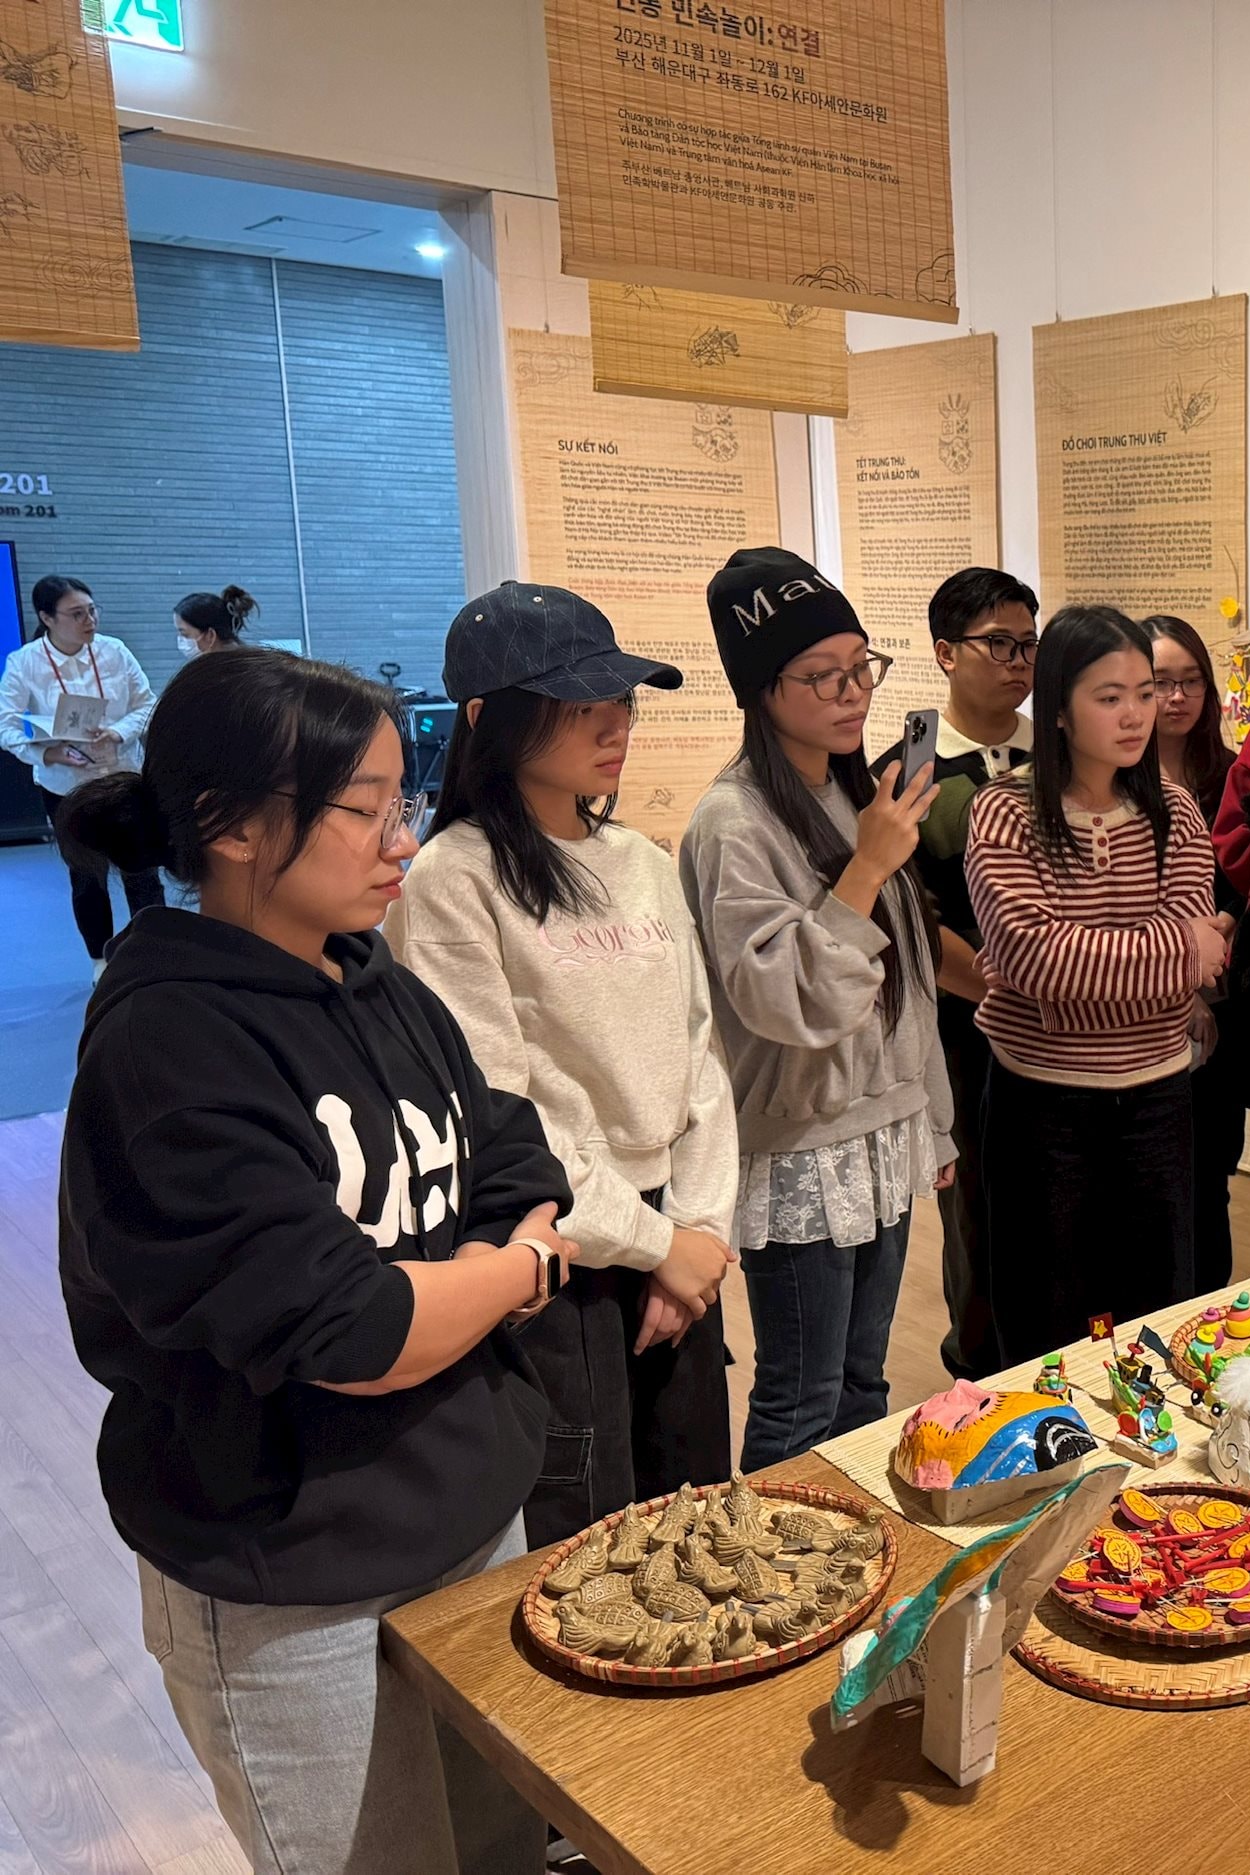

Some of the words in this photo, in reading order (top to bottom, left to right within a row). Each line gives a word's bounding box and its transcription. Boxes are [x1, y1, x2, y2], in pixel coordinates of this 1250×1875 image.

[778, 23, 821, 57] 연결
[614, 25, 667, 50] 2025년
[673, 39, 704, 62] 11월
[710, 48, 732, 68] 1일
[750, 57, 779, 79] 12월
[784, 65, 806, 84] 1일
[615, 48, 646, 71] 부산
[651, 56, 710, 84] 해운대구
[716, 72, 759, 94] 좌동로
[763, 82, 789, 101] 162
[792, 88, 888, 123] KF아세안문화원
[558, 440, 573, 453] SỰ
[576, 438, 596, 453] KẾT
[599, 441, 619, 455] NỐI
[1062, 435, 1075, 451] ĐỒ
[1076, 437, 1096, 450] CHƠI
[1098, 435, 1127, 448] TRUNG
[1128, 433, 1146, 446] THU
[1148, 429, 1167, 447] VIỆT
[868, 457, 890, 467] TRUNG
[0, 472, 53, 496] 201
[25, 505, 57, 518] 201
